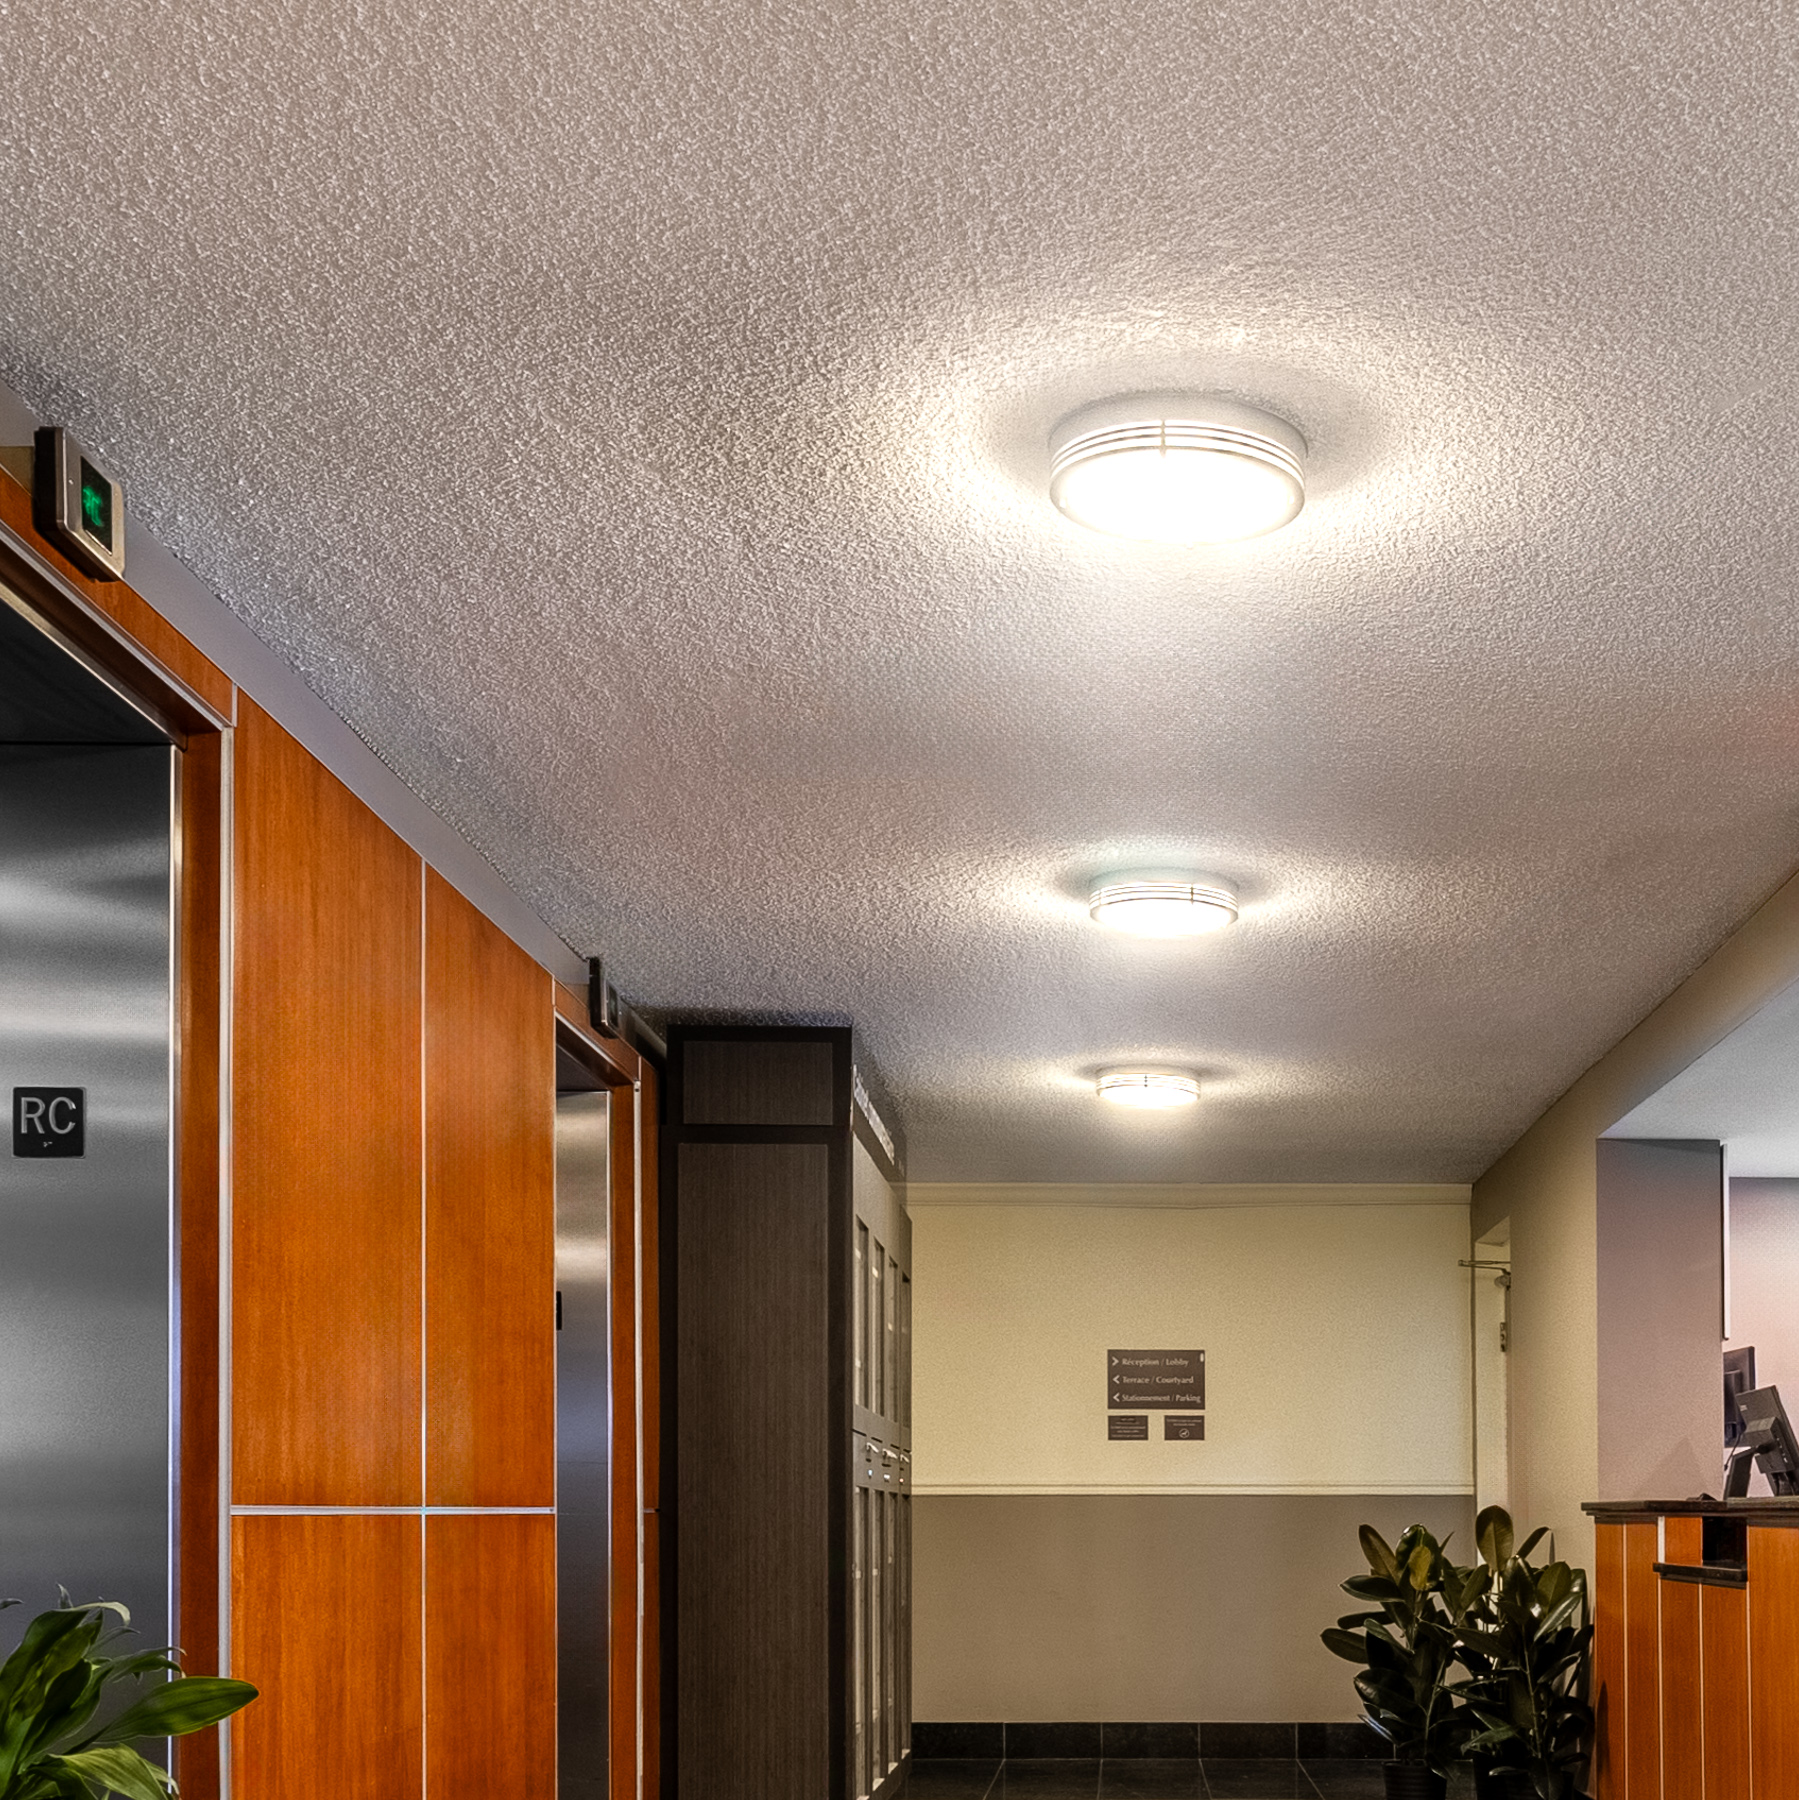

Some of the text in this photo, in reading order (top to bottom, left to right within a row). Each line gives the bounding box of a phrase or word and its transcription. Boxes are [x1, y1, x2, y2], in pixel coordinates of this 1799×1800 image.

[21, 1096, 77, 1135] RC
[1156, 1376, 1194, 1385] Courtyard
[1176, 1394, 1201, 1403] Parking
